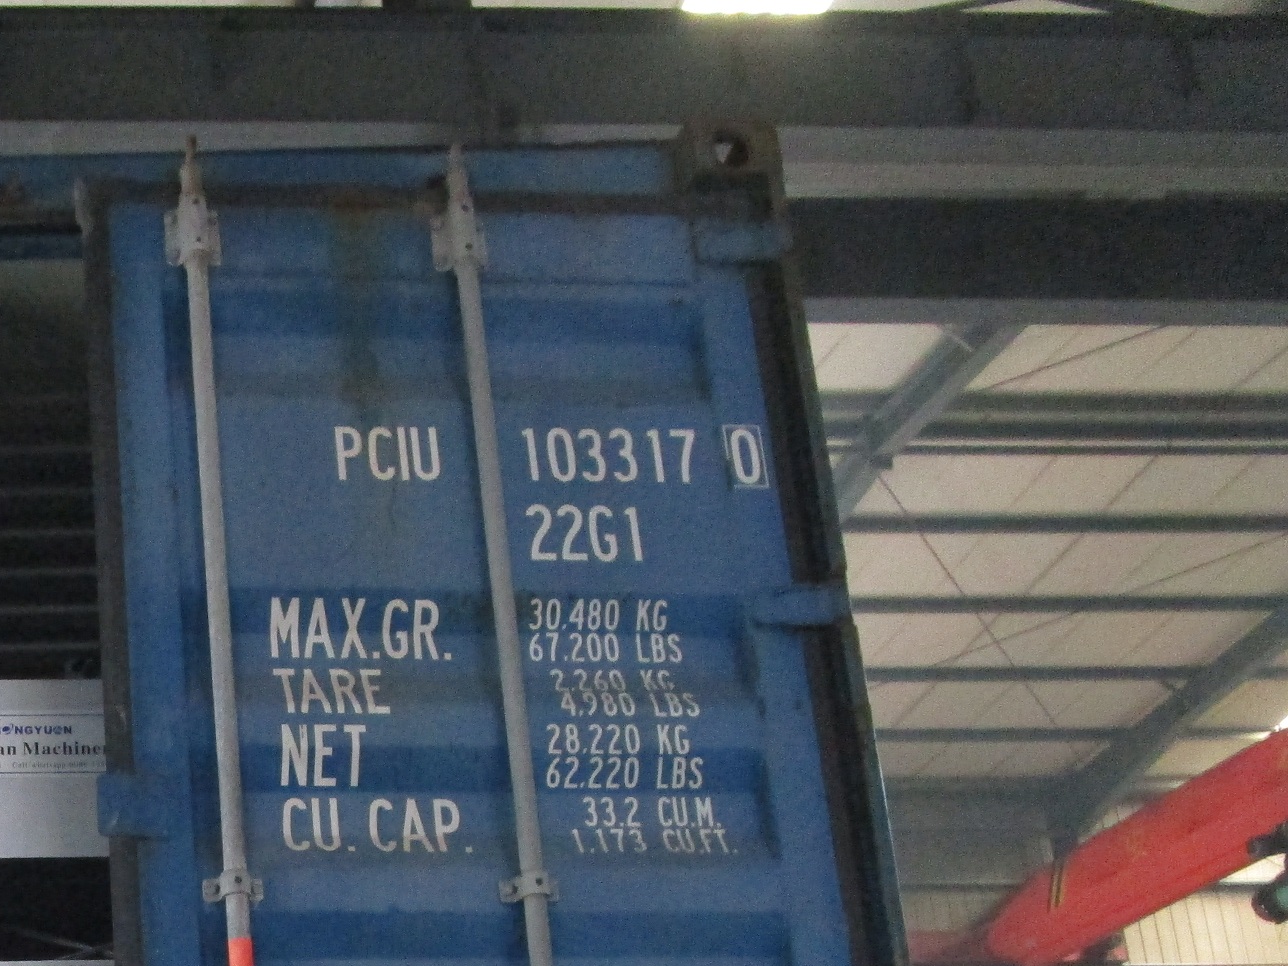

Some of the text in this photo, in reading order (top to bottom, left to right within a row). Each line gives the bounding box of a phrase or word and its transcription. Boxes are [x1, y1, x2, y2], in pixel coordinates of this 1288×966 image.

[334, 426, 762, 485] PCIU 103317 0
[525, 503, 644, 562] 22G1
[269, 597, 452, 660] MAX.GR.
[636, 599, 668, 632] KG
[635, 633, 683, 663] LBS
[272, 668, 391, 714] TARE
[640, 669, 675, 691] KG
[650, 693, 700, 717] LBS
[280, 723, 367, 787] NET
[657, 724, 690, 755] KG
[656, 756, 704, 789] LBS
[582, 796, 642, 828] 33.2
